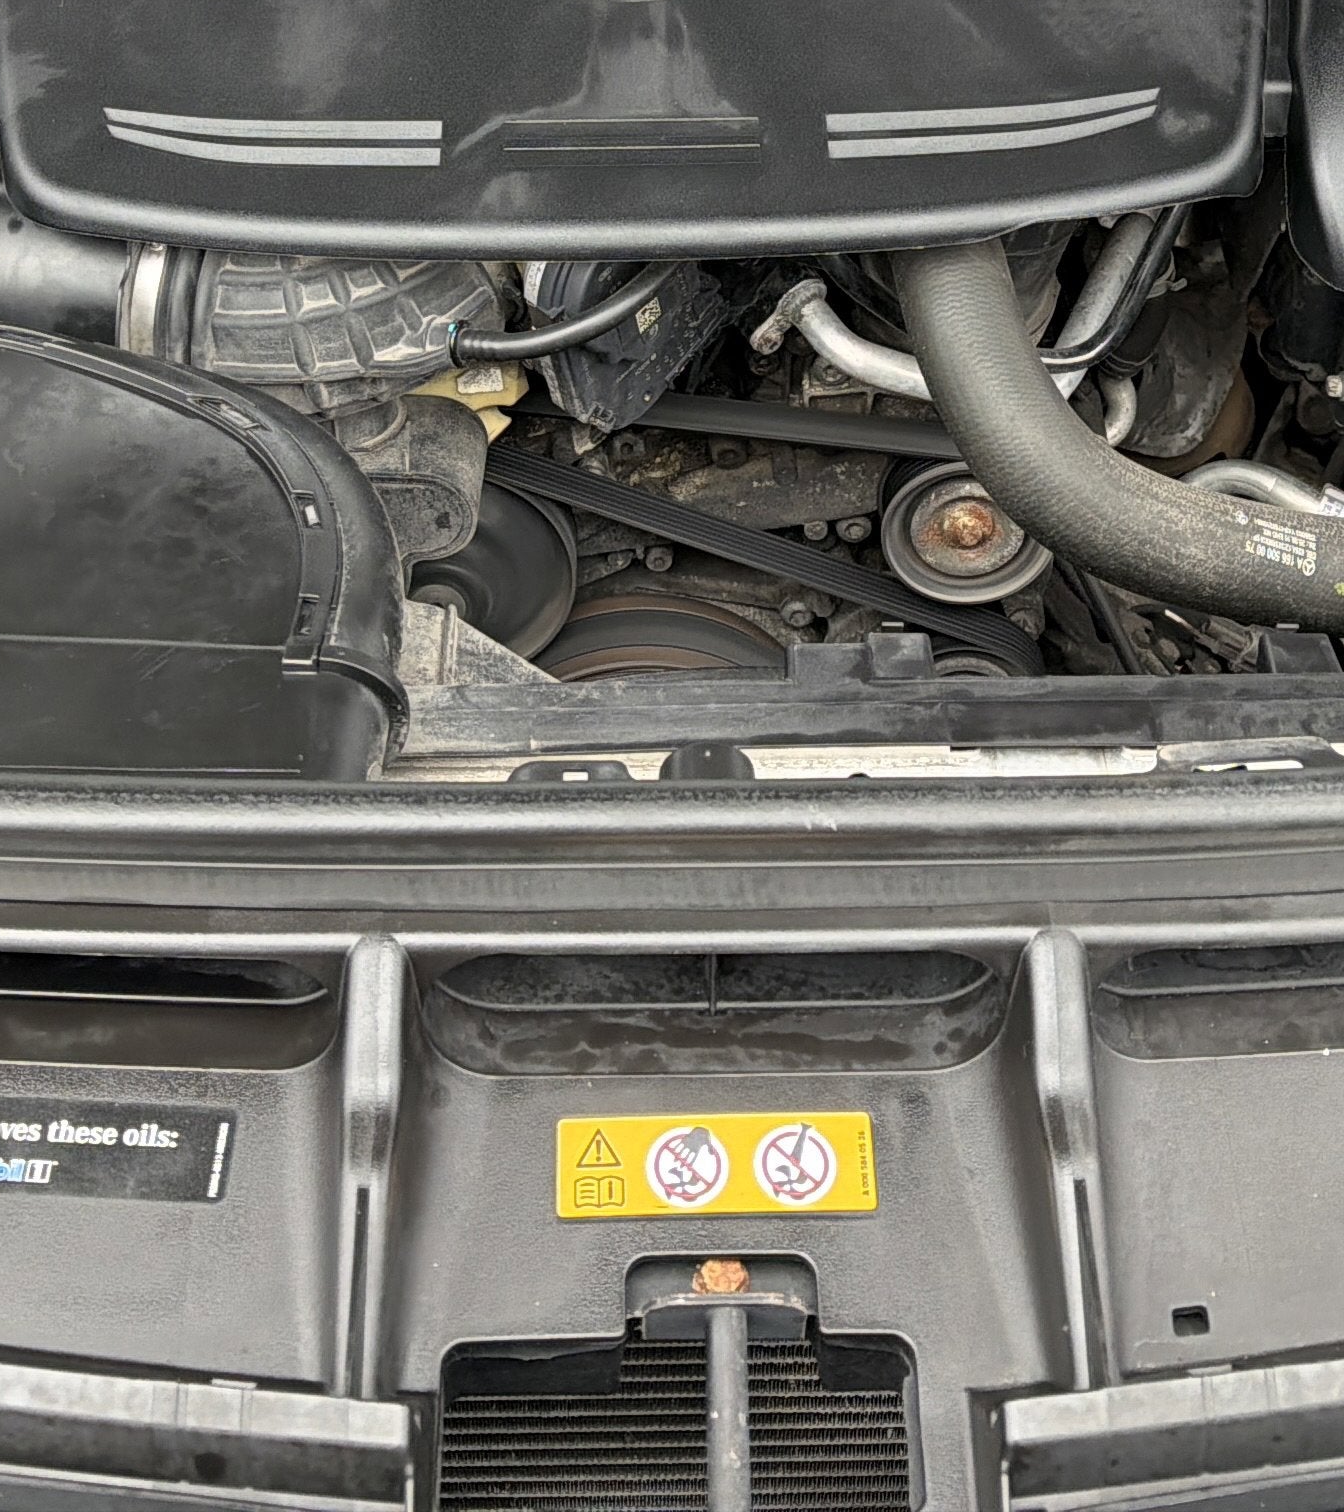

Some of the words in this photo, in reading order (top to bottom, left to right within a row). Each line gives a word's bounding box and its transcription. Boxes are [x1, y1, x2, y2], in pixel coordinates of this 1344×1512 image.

[1296, 556, 1304, 569] A
[47, 1119, 118, 1145] these
[123, 1122, 179, 1148] oils:
